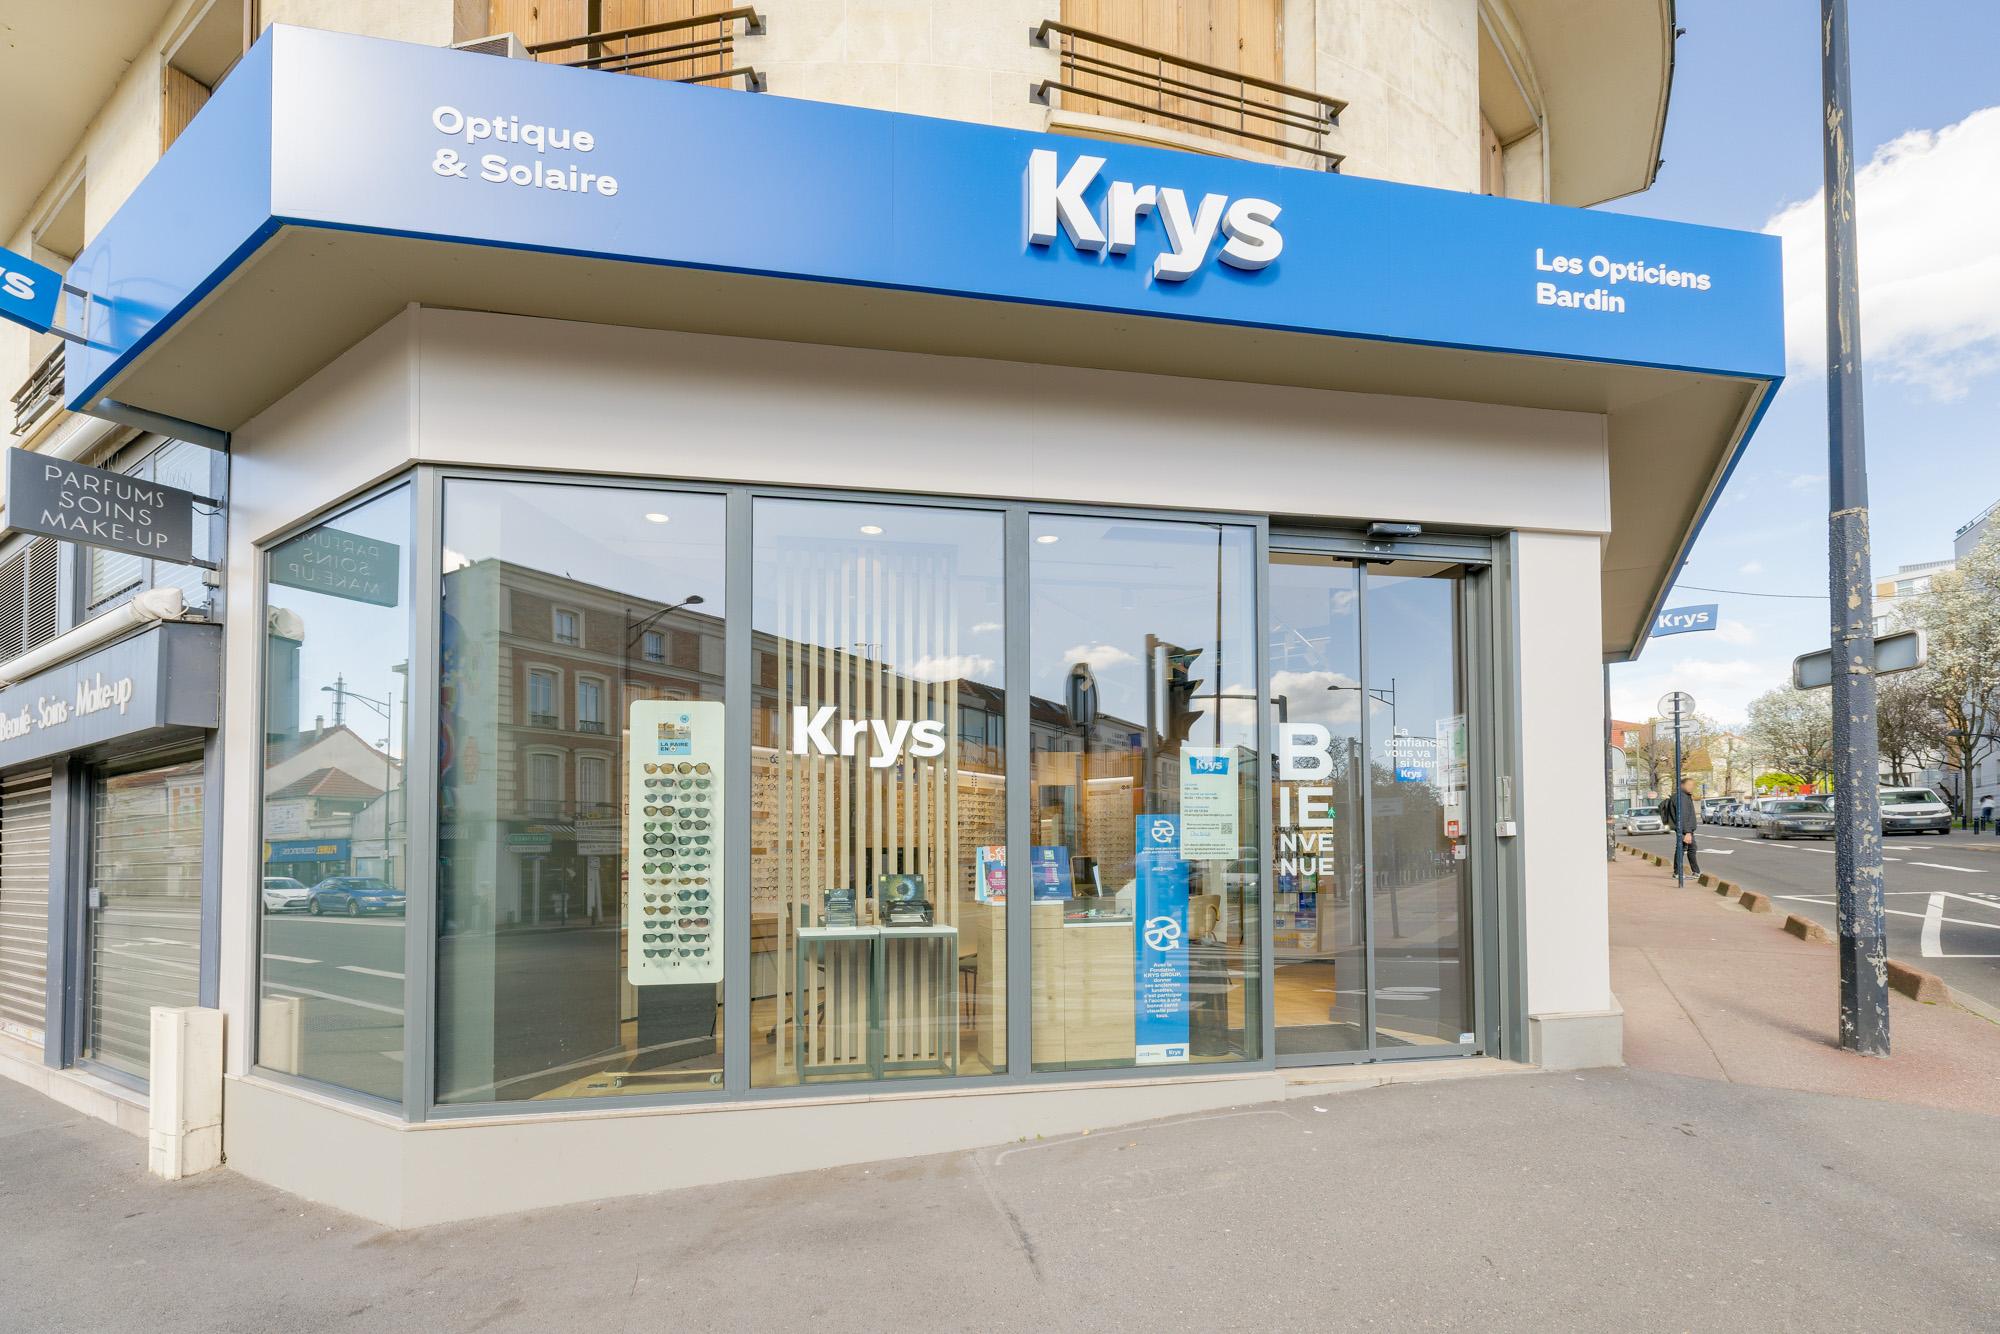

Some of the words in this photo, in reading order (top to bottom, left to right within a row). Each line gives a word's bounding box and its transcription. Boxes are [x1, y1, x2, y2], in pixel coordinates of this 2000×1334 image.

[432, 106, 594, 153] Optique
[432, 148, 468, 178] &
[480, 154, 618, 196] Solaire
[1028, 149, 1283, 281] Krys
[1536, 248, 1583, 275] Les
[1588, 255, 1712, 291] Opticiens
[1536, 282, 1625, 313] Bardin
[44, 464, 164, 508] PARFUMS
[59, 491, 152, 526] SOINS
[40, 509, 168, 549] MAKE-UP
[1659, 612, 1709, 628] Krys
[38, 695, 67, 729] Soins
[76, 672, 132, 717] Make-up
[793, 705, 945, 768] Krys
[1394, 726, 1408, 736] La
[1196, 759, 1223, 771] Krys
[1384, 750, 1414, 758] vous
[1416, 750, 1431, 758] va
[1400, 758, 1410, 768] si
[1400, 770, 1422, 779] Krys
[1280, 834, 1334, 852] NVE
[1280, 858, 1335, 876] NUE
